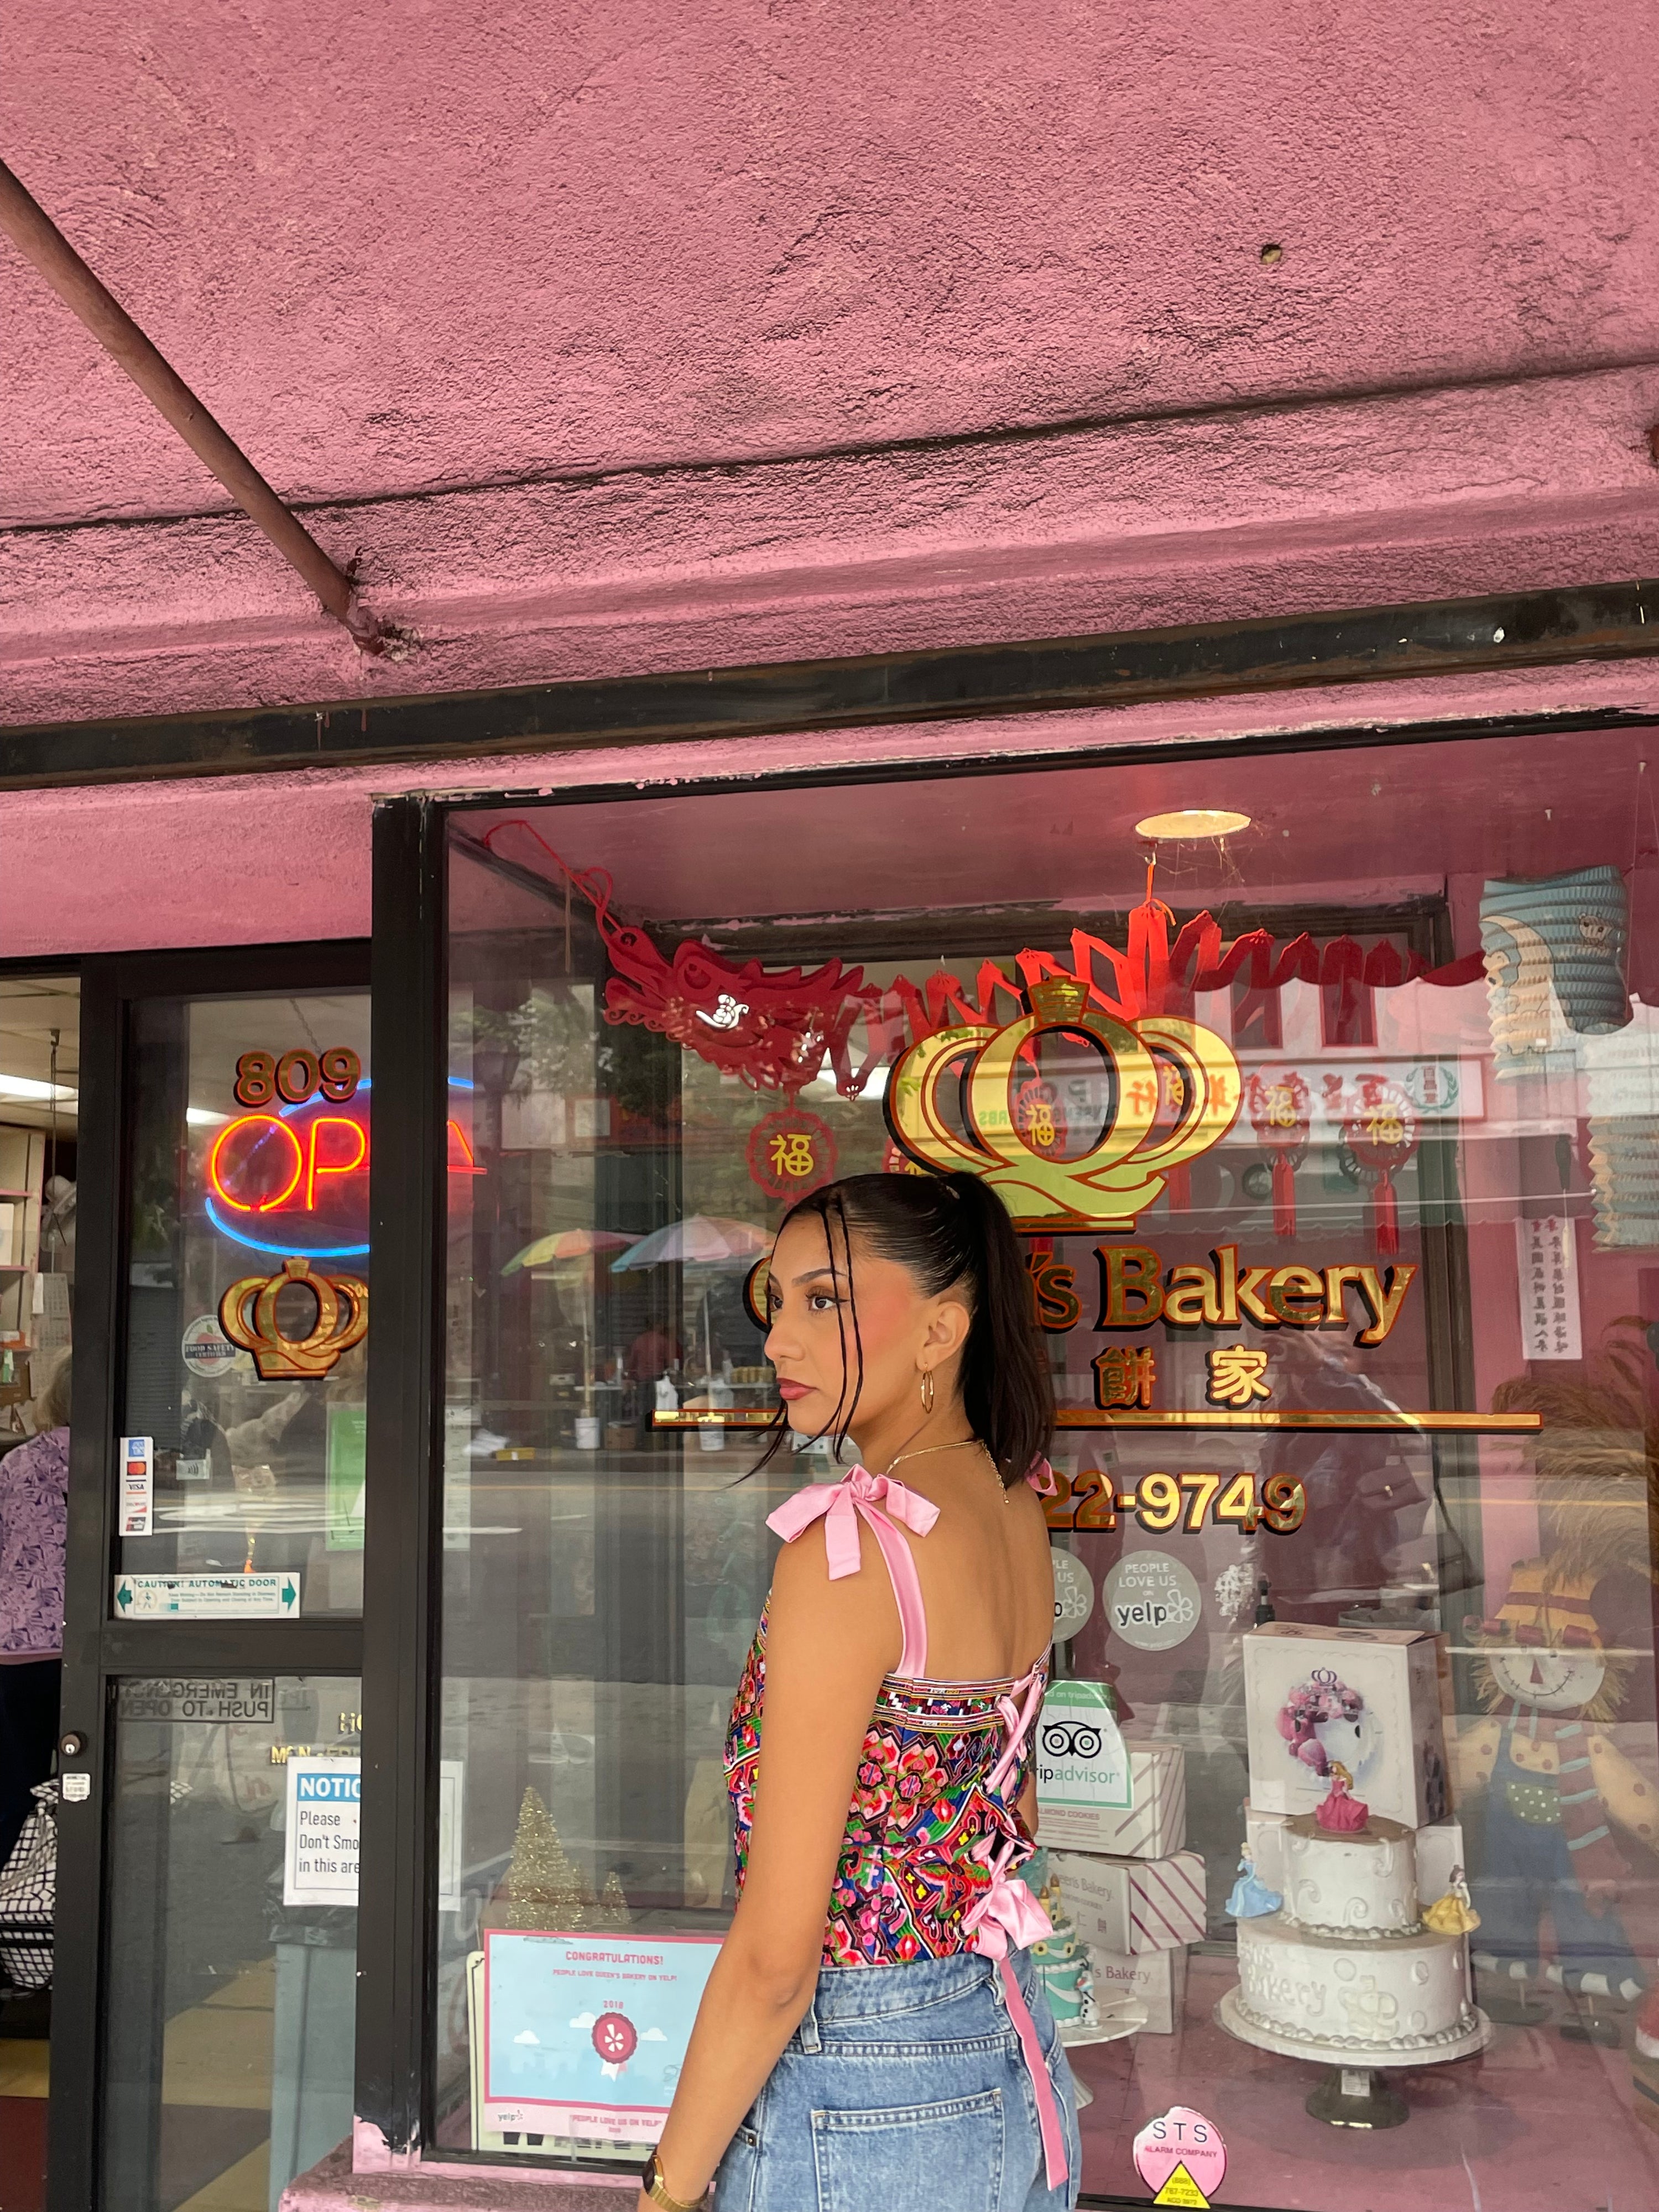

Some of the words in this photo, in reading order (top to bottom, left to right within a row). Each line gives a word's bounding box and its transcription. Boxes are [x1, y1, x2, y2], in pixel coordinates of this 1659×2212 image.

[234, 1047, 361, 1107] 809
[1363, 1105, 1404, 1146] 福
[211, 1114, 366, 1212] OP
[770, 1134, 814, 1176] 福
[1093, 1244, 1419, 1349] Bakery
[1040, 1469, 1307, 1535] 22-9749
[1057, 1572, 1074, 1583] US
[1125, 1563, 1170, 1574] PEOPLE
[249, 1578, 276, 1587] DOOR
[1119, 1575, 1155, 1588] LOVE
[1159, 1575, 1177, 1587] US
[1117, 1602, 1167, 1626] yelp
[1036, 1764, 1115, 1784] ipadvisor
[300, 1777, 361, 1798] NOTIC
[300, 1811, 341, 1826] Please
[1039, 1808, 1066, 1817] LMOND
[299, 1834, 329, 1849] Don't
[333, 1835, 359, 1850] Smo
[299, 1858, 310, 1872] in
[314, 1859, 337, 1873] this
[341, 1862, 359, 1874] are
[566, 1950, 664, 1965] CONGRATULATIONS!
[1105, 1965, 1151, 1985] Bakery
[497, 2112, 517, 2122] yelp
[1152, 2121, 1208, 2143] STS
[1145, 2146, 1173, 2154] ALARM
[1175, 2147, 1217, 2157] COMPANY
